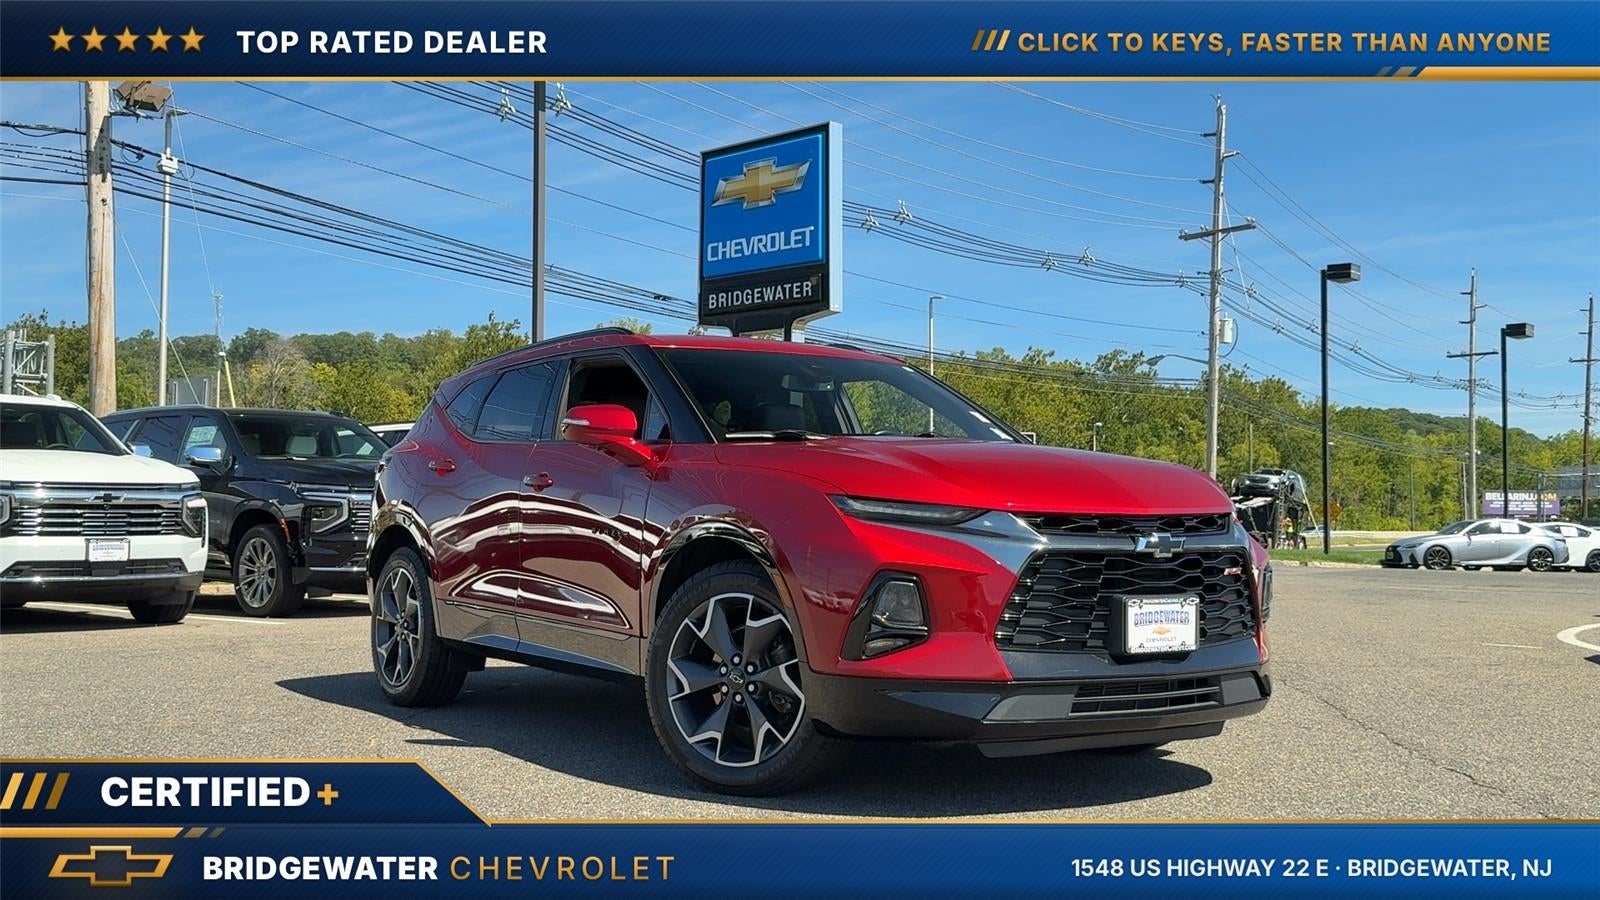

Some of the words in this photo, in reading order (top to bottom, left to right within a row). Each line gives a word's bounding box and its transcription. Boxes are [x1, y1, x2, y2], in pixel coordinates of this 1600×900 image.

[707, 226, 814, 262] CHEVROLET
[708, 280, 812, 309] BRIDGEWATER
[1134, 610, 1190, 626] BRIDGEWATER
